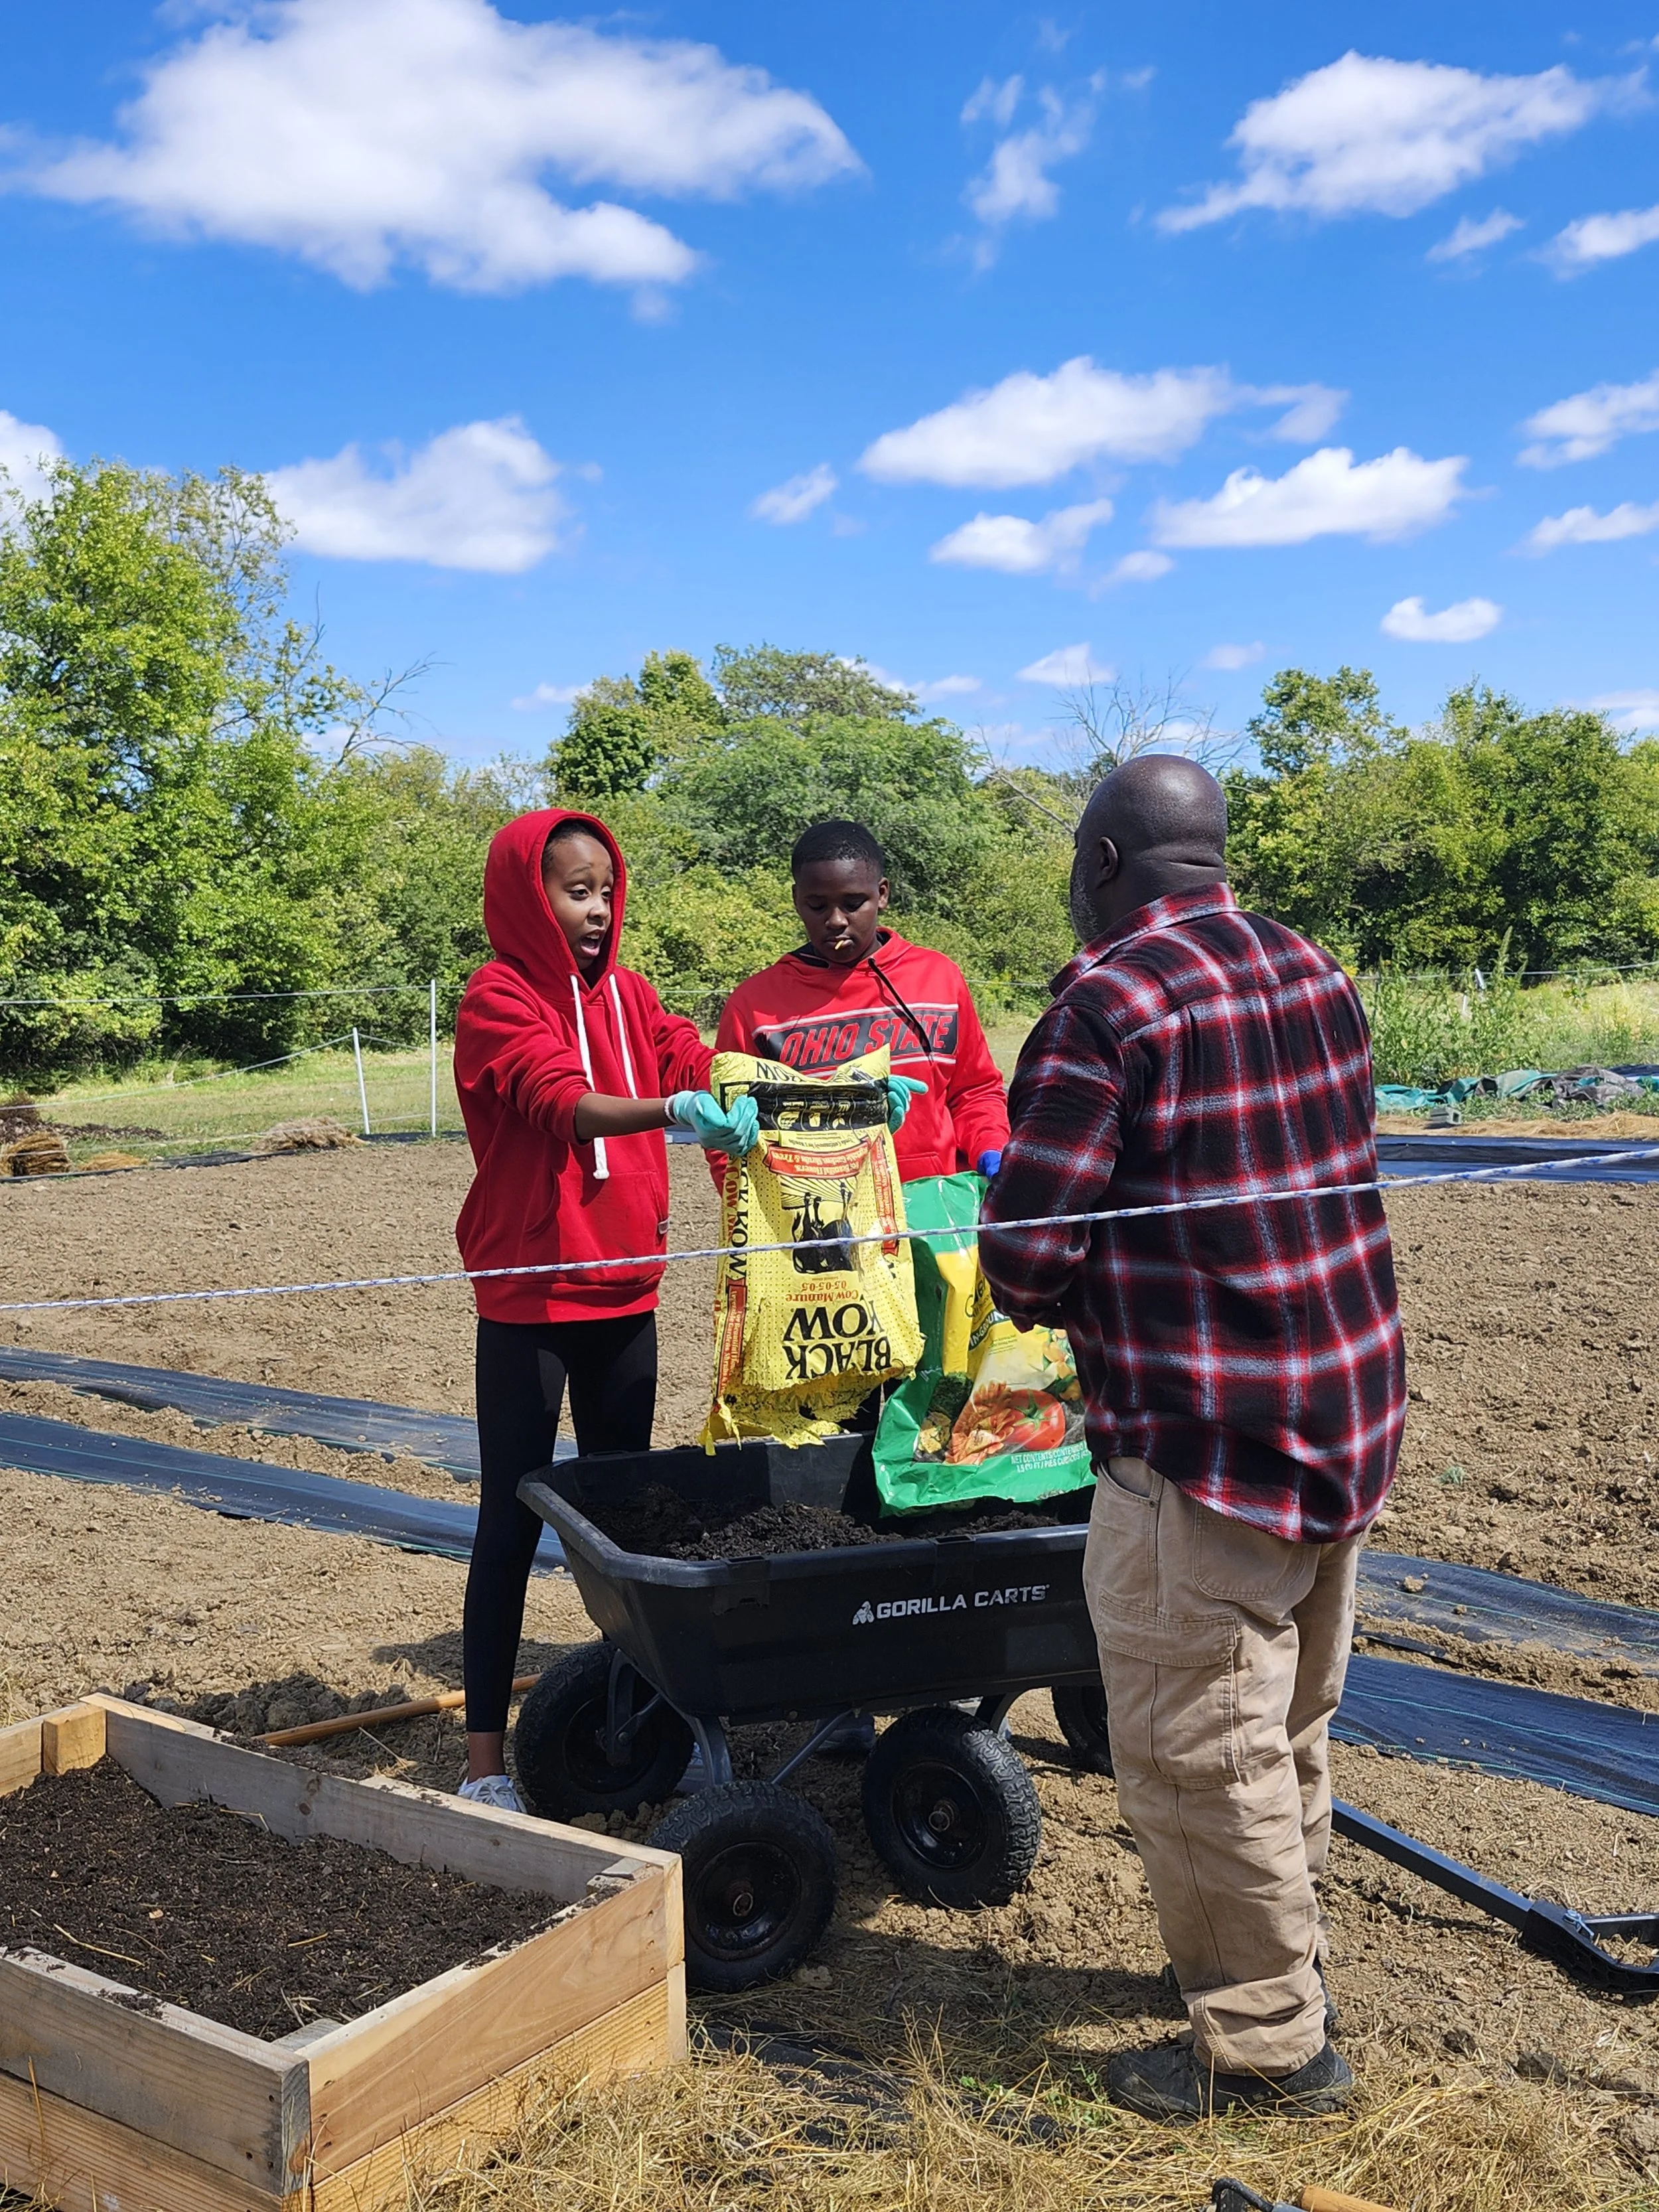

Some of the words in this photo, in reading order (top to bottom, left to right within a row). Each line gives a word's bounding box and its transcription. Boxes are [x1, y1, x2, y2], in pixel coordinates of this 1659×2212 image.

[780, 1023, 861, 1067] OHIO
[863, 1015, 954, 1053] STATE
[785, 1293, 834, 1302] Manure
[835, 1290, 859, 1300] Cow
[782, 1294, 885, 1342] KOW
[731, 1322, 741, 1354] Beautiful
[782, 1336, 892, 1380] BLACK
[876, 1594, 967, 1619] GORILLA
[974, 1585, 1046, 1607] CARTS
